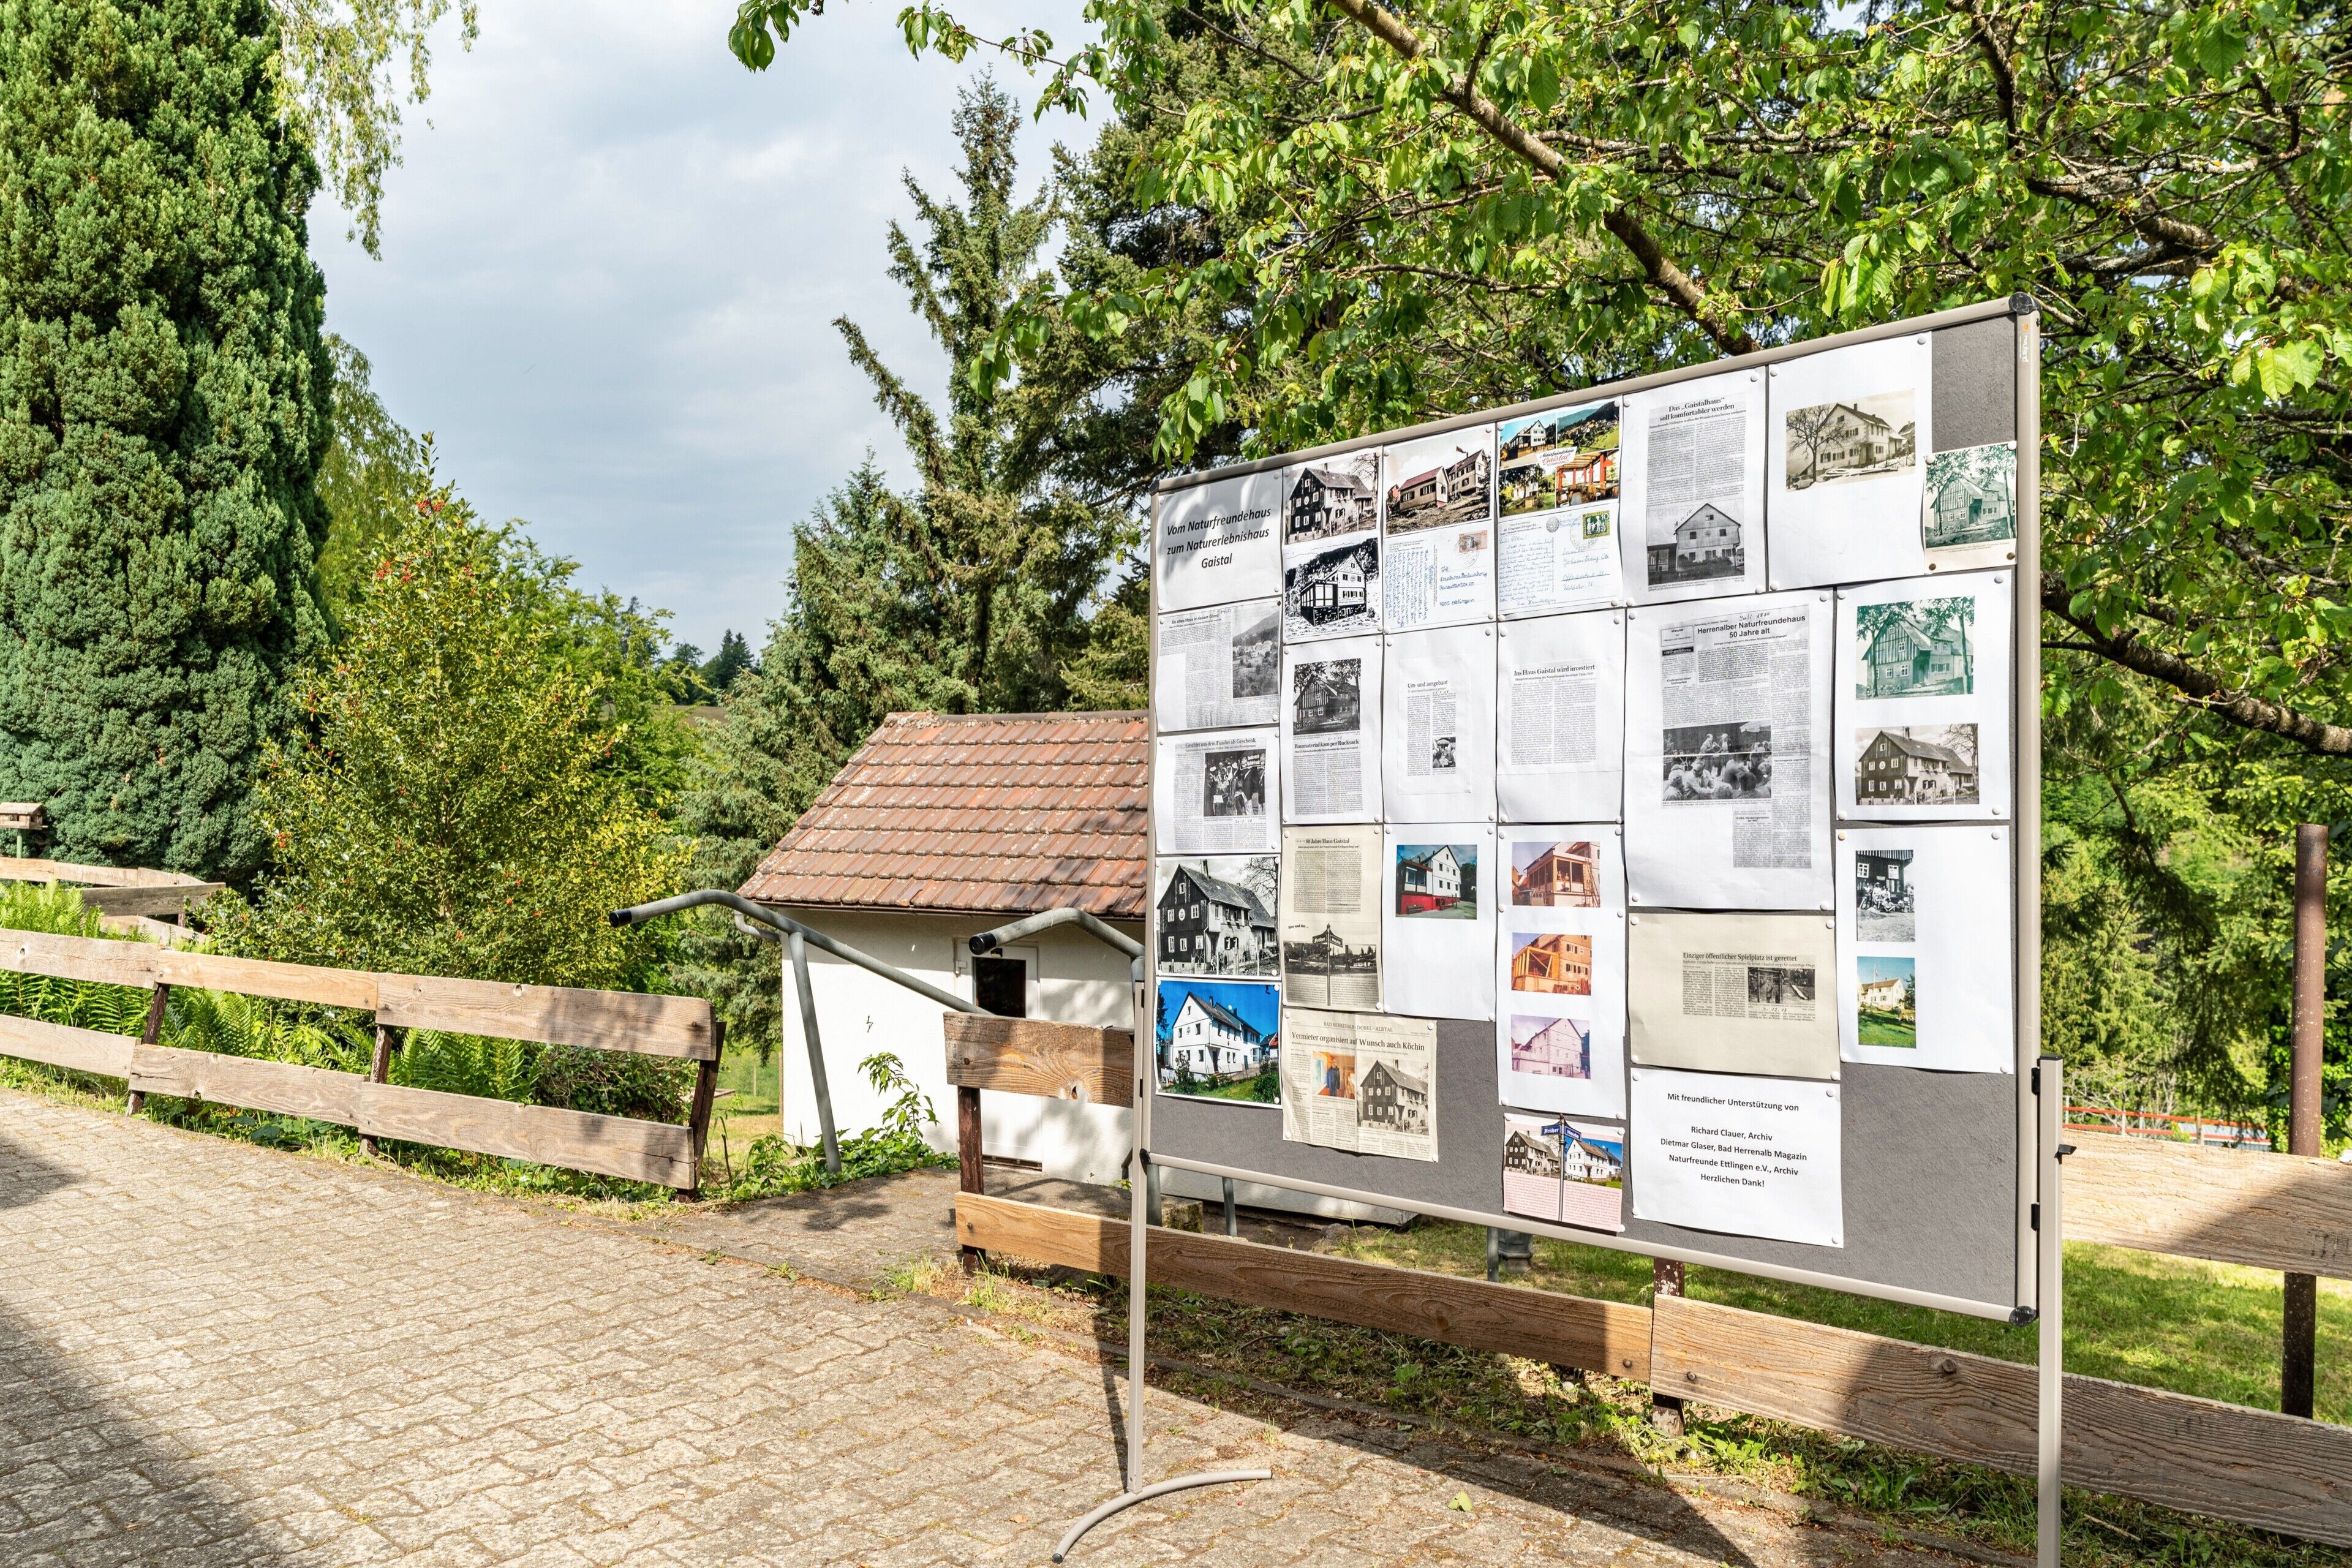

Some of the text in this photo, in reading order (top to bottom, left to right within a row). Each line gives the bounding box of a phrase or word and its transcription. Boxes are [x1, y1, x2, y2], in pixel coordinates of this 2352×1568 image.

[1671, 407, 1709, 419] komfortabler
[1542, 453, 1570, 465] Gaistal
[1167, 508, 1271, 535] Vom Naturfreundehaus
[1167, 529, 1269, 555] zum Naturerlebnishaus
[1202, 553, 1232, 568] Gaistal
[1698, 615, 1806, 634] Herrenalber Naturfreundehaus
[1738, 954, 1765, 962] Spielplatz
[1292, 1032, 1319, 1041] Vermieter
[1320, 1036, 1348, 1044] organisiert
[1359, 1039, 1385, 1047] Wunsch
[1403, 1042, 1425, 1051] Köchin
[1681, 1095, 1725, 1105] freundlicher
[1728, 1099, 1782, 1111] Unterstützung
[1567, 1129, 1580, 1139] Heute
[1691, 1126, 1773, 1141] Richard Clauer, Archiv
[1661, 1139, 1689, 1148] Dietmar
[1691, 1142, 1716, 1152] Glaser,
[1735, 1147, 1772, 1156] Herrenalb
[1774, 1151, 1807, 1161] Magazin
[1669, 1155, 1798, 1175] Naturfreunde Ettlingen e.V., Archiv
[1701, 1174, 1765, 1188] Herzlichen Dank!
